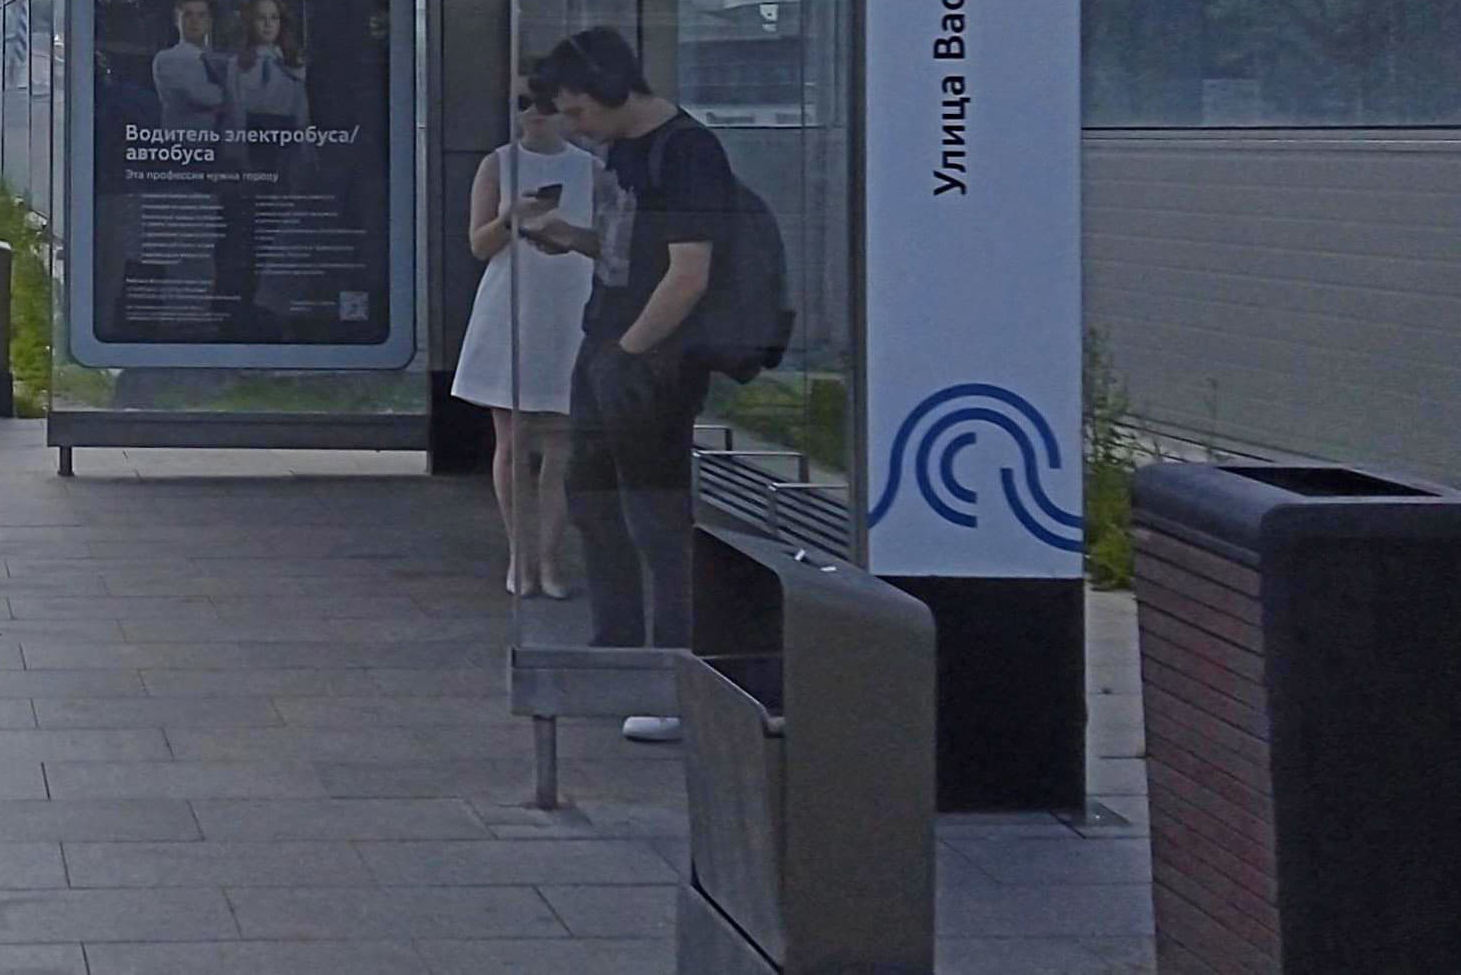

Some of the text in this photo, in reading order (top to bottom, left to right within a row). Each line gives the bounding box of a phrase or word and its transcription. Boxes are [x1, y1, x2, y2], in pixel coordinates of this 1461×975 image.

[125, 124, 360, 146] Водитель электробуса/
[933, 75, 971, 196] Улица
[125, 144, 215, 165] автобуса
[125, 169, 144, 181] Эта
